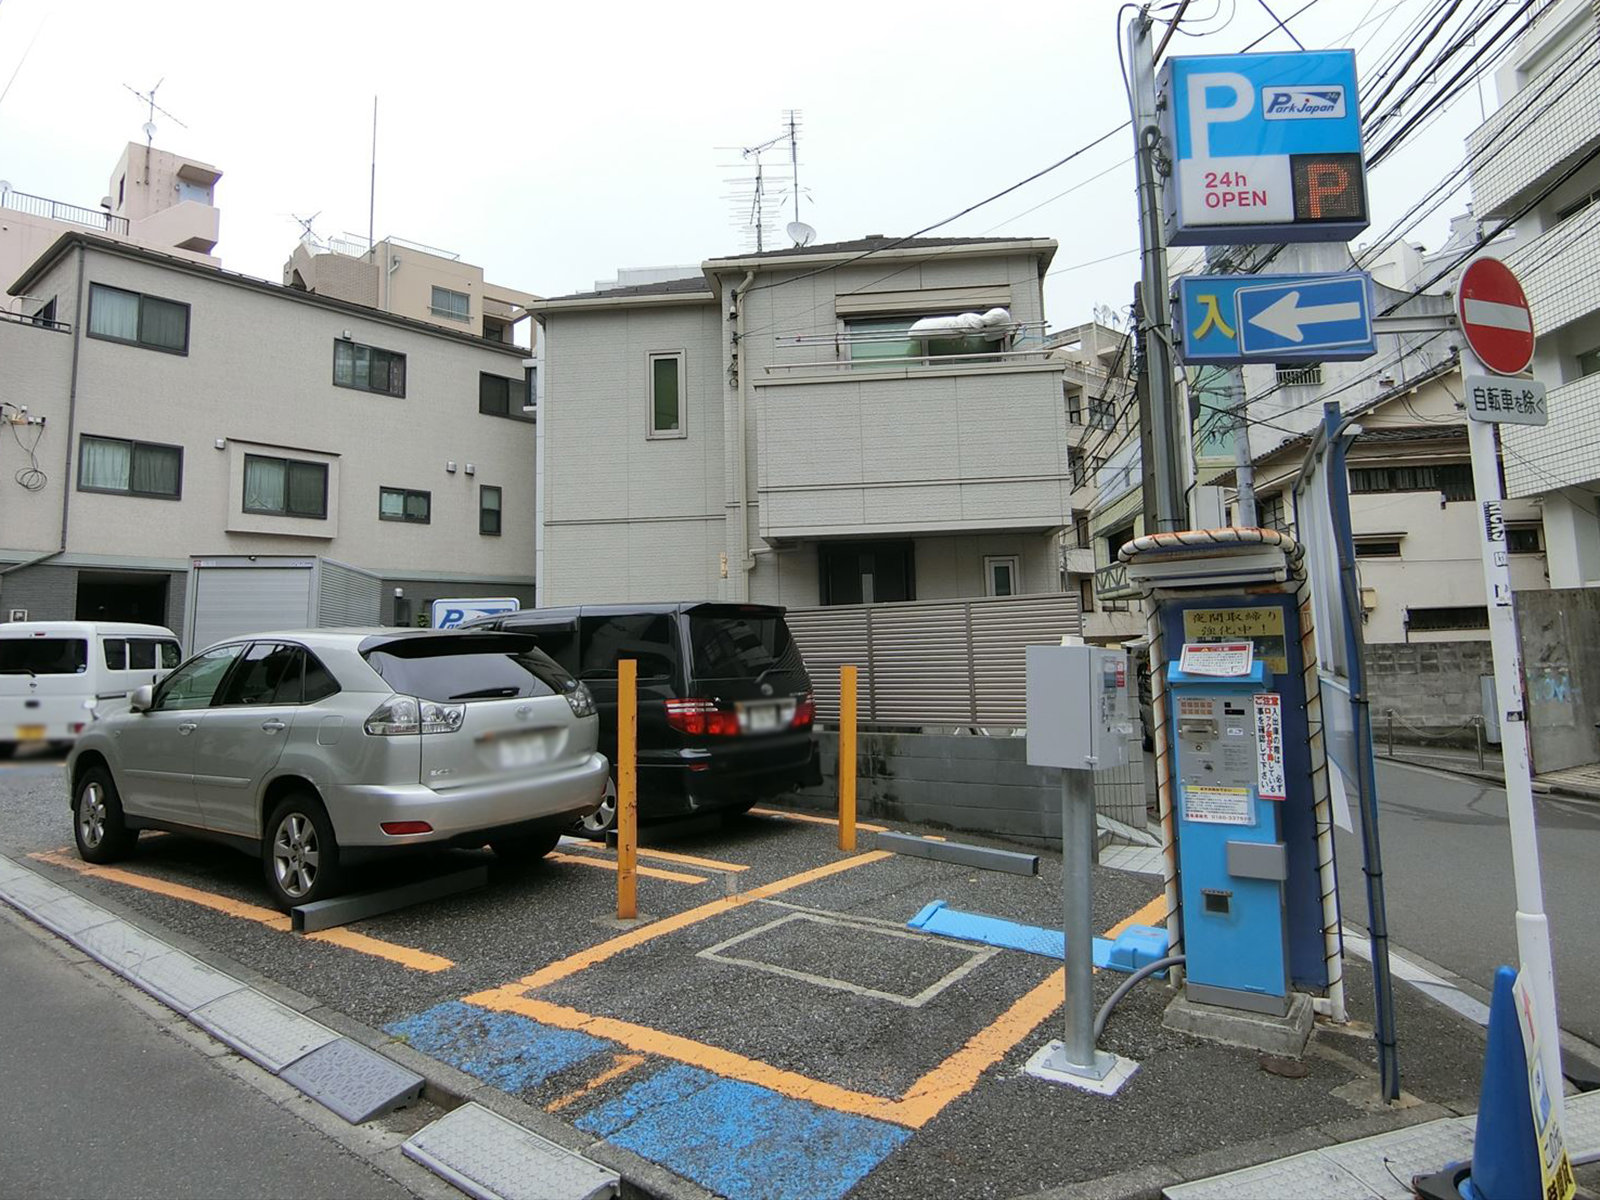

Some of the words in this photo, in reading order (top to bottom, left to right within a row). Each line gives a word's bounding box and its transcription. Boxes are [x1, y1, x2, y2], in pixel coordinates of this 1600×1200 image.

[1187, 72, 1254, 160] P
[1205, 172, 1247, 188] 24h
[1307, 163, 1348, 218] P
[1205, 190, 1267, 208] OPEN
[1193, 295, 1236, 339] 入
[1473, 386, 1545, 415] 自転車を除く
[1192, 611, 1276, 623] 夜間取締り
[1255, 697, 1278, 706] ご注意
